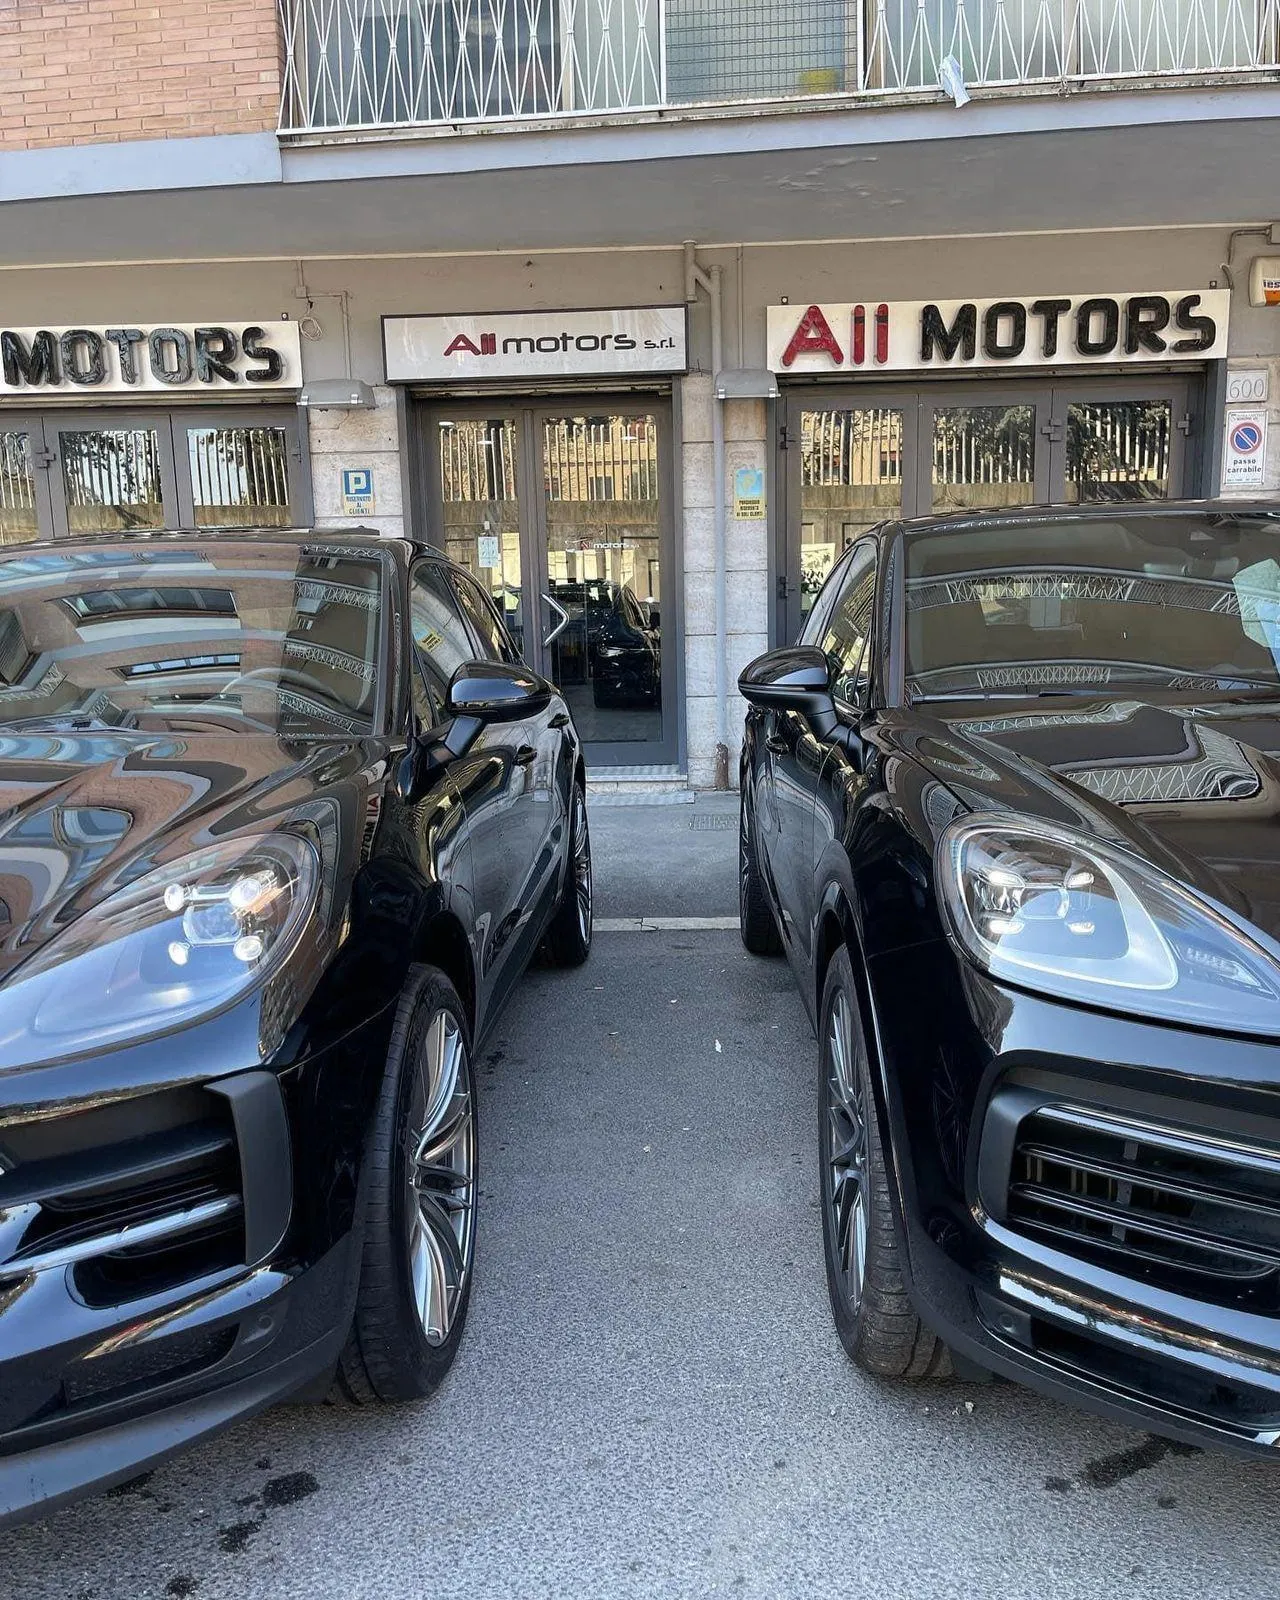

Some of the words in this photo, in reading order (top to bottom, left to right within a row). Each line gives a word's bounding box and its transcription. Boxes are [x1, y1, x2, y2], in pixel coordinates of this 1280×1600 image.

[782, 304, 889, 366] All
[920, 294, 1217, 361] MOTORS
[1, 326, 283, 386] MOTORS
[443, 333, 497, 357] All
[502, 332, 637, 354] motors
[1230, 379, 1264, 399] 600
[1227, 466, 1262, 474] carrabile
[348, 472, 367, 494] P
